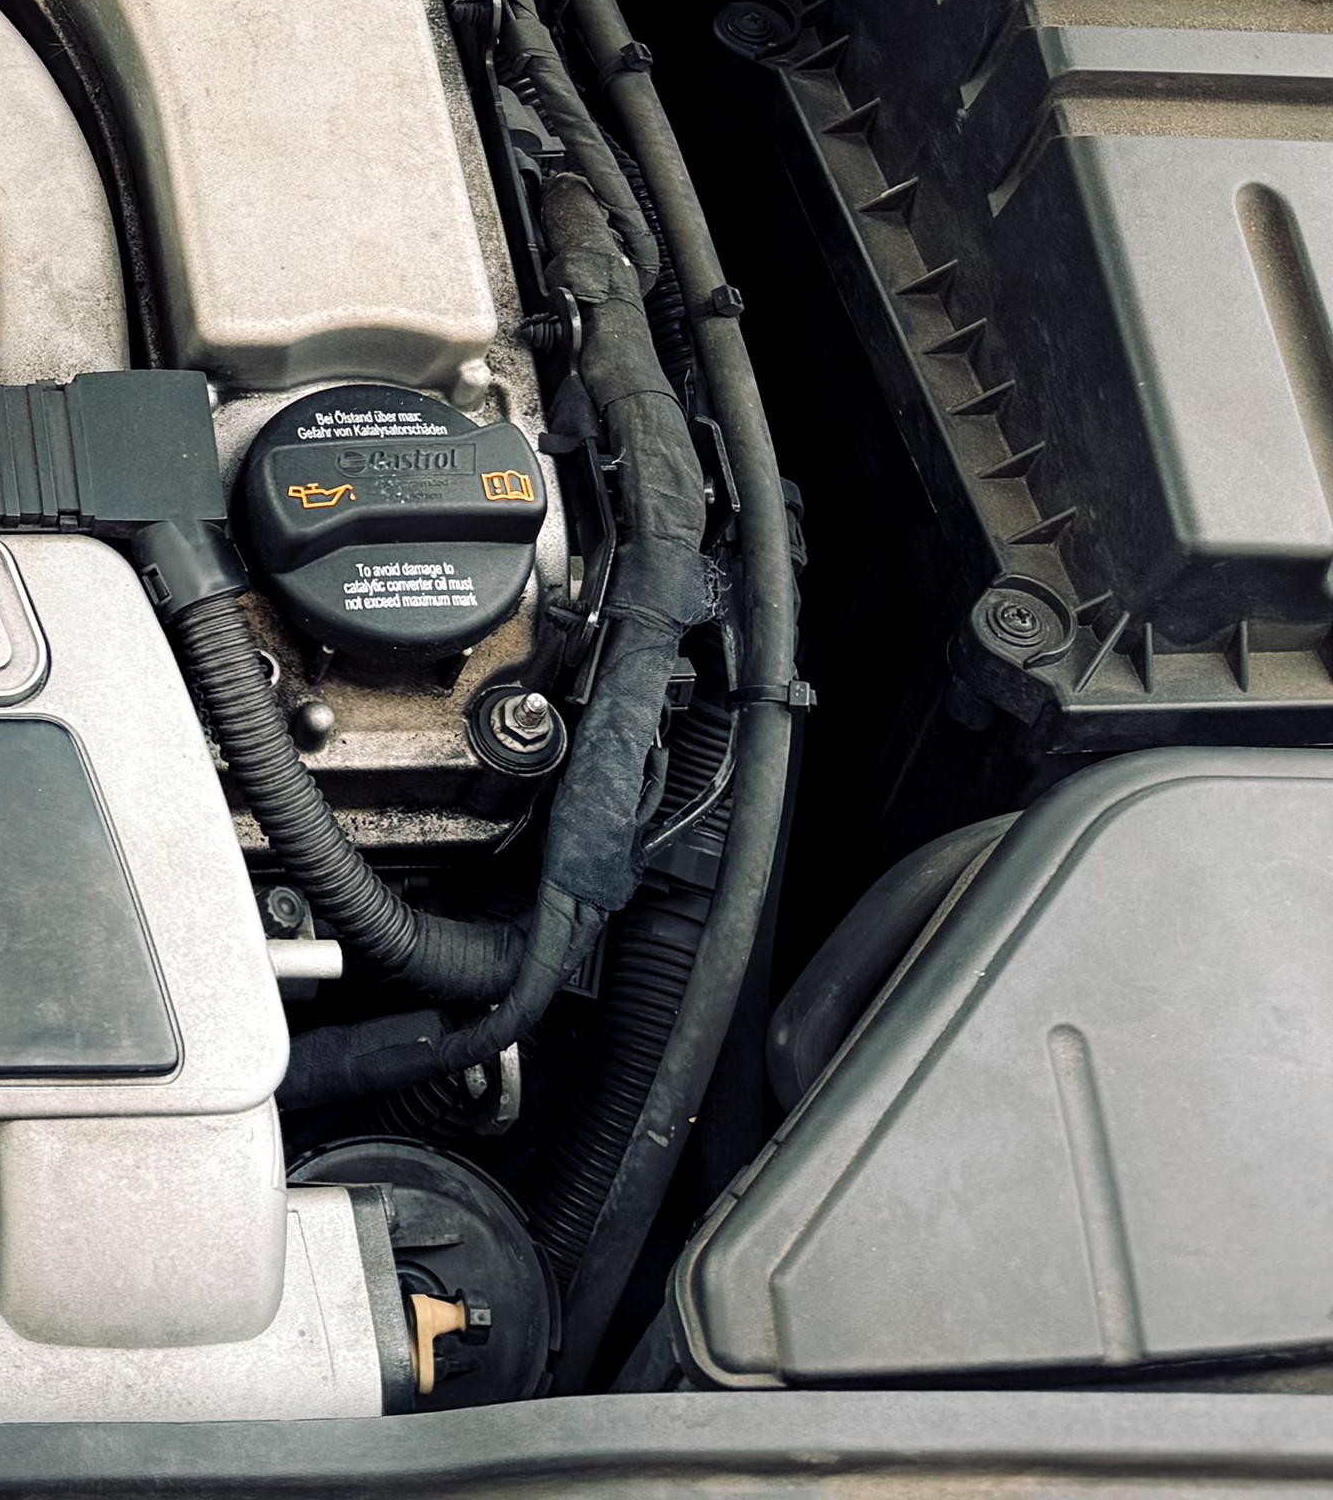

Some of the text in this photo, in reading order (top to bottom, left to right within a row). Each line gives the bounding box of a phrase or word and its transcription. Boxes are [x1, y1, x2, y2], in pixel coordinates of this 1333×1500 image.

[315, 411, 334, 425] Bei
[334, 409, 373, 424] Ölstand
[374, 409, 398, 424] über
[298, 424, 448, 440] Gefahr von Katalysatorschäden
[369, 447, 458, 471] Castrol
[356, 563, 455, 578] To avoid damage to
[343, 578, 473, 595] catalytic converter oil must
[345, 594, 478, 610] not exceed maximum mark
